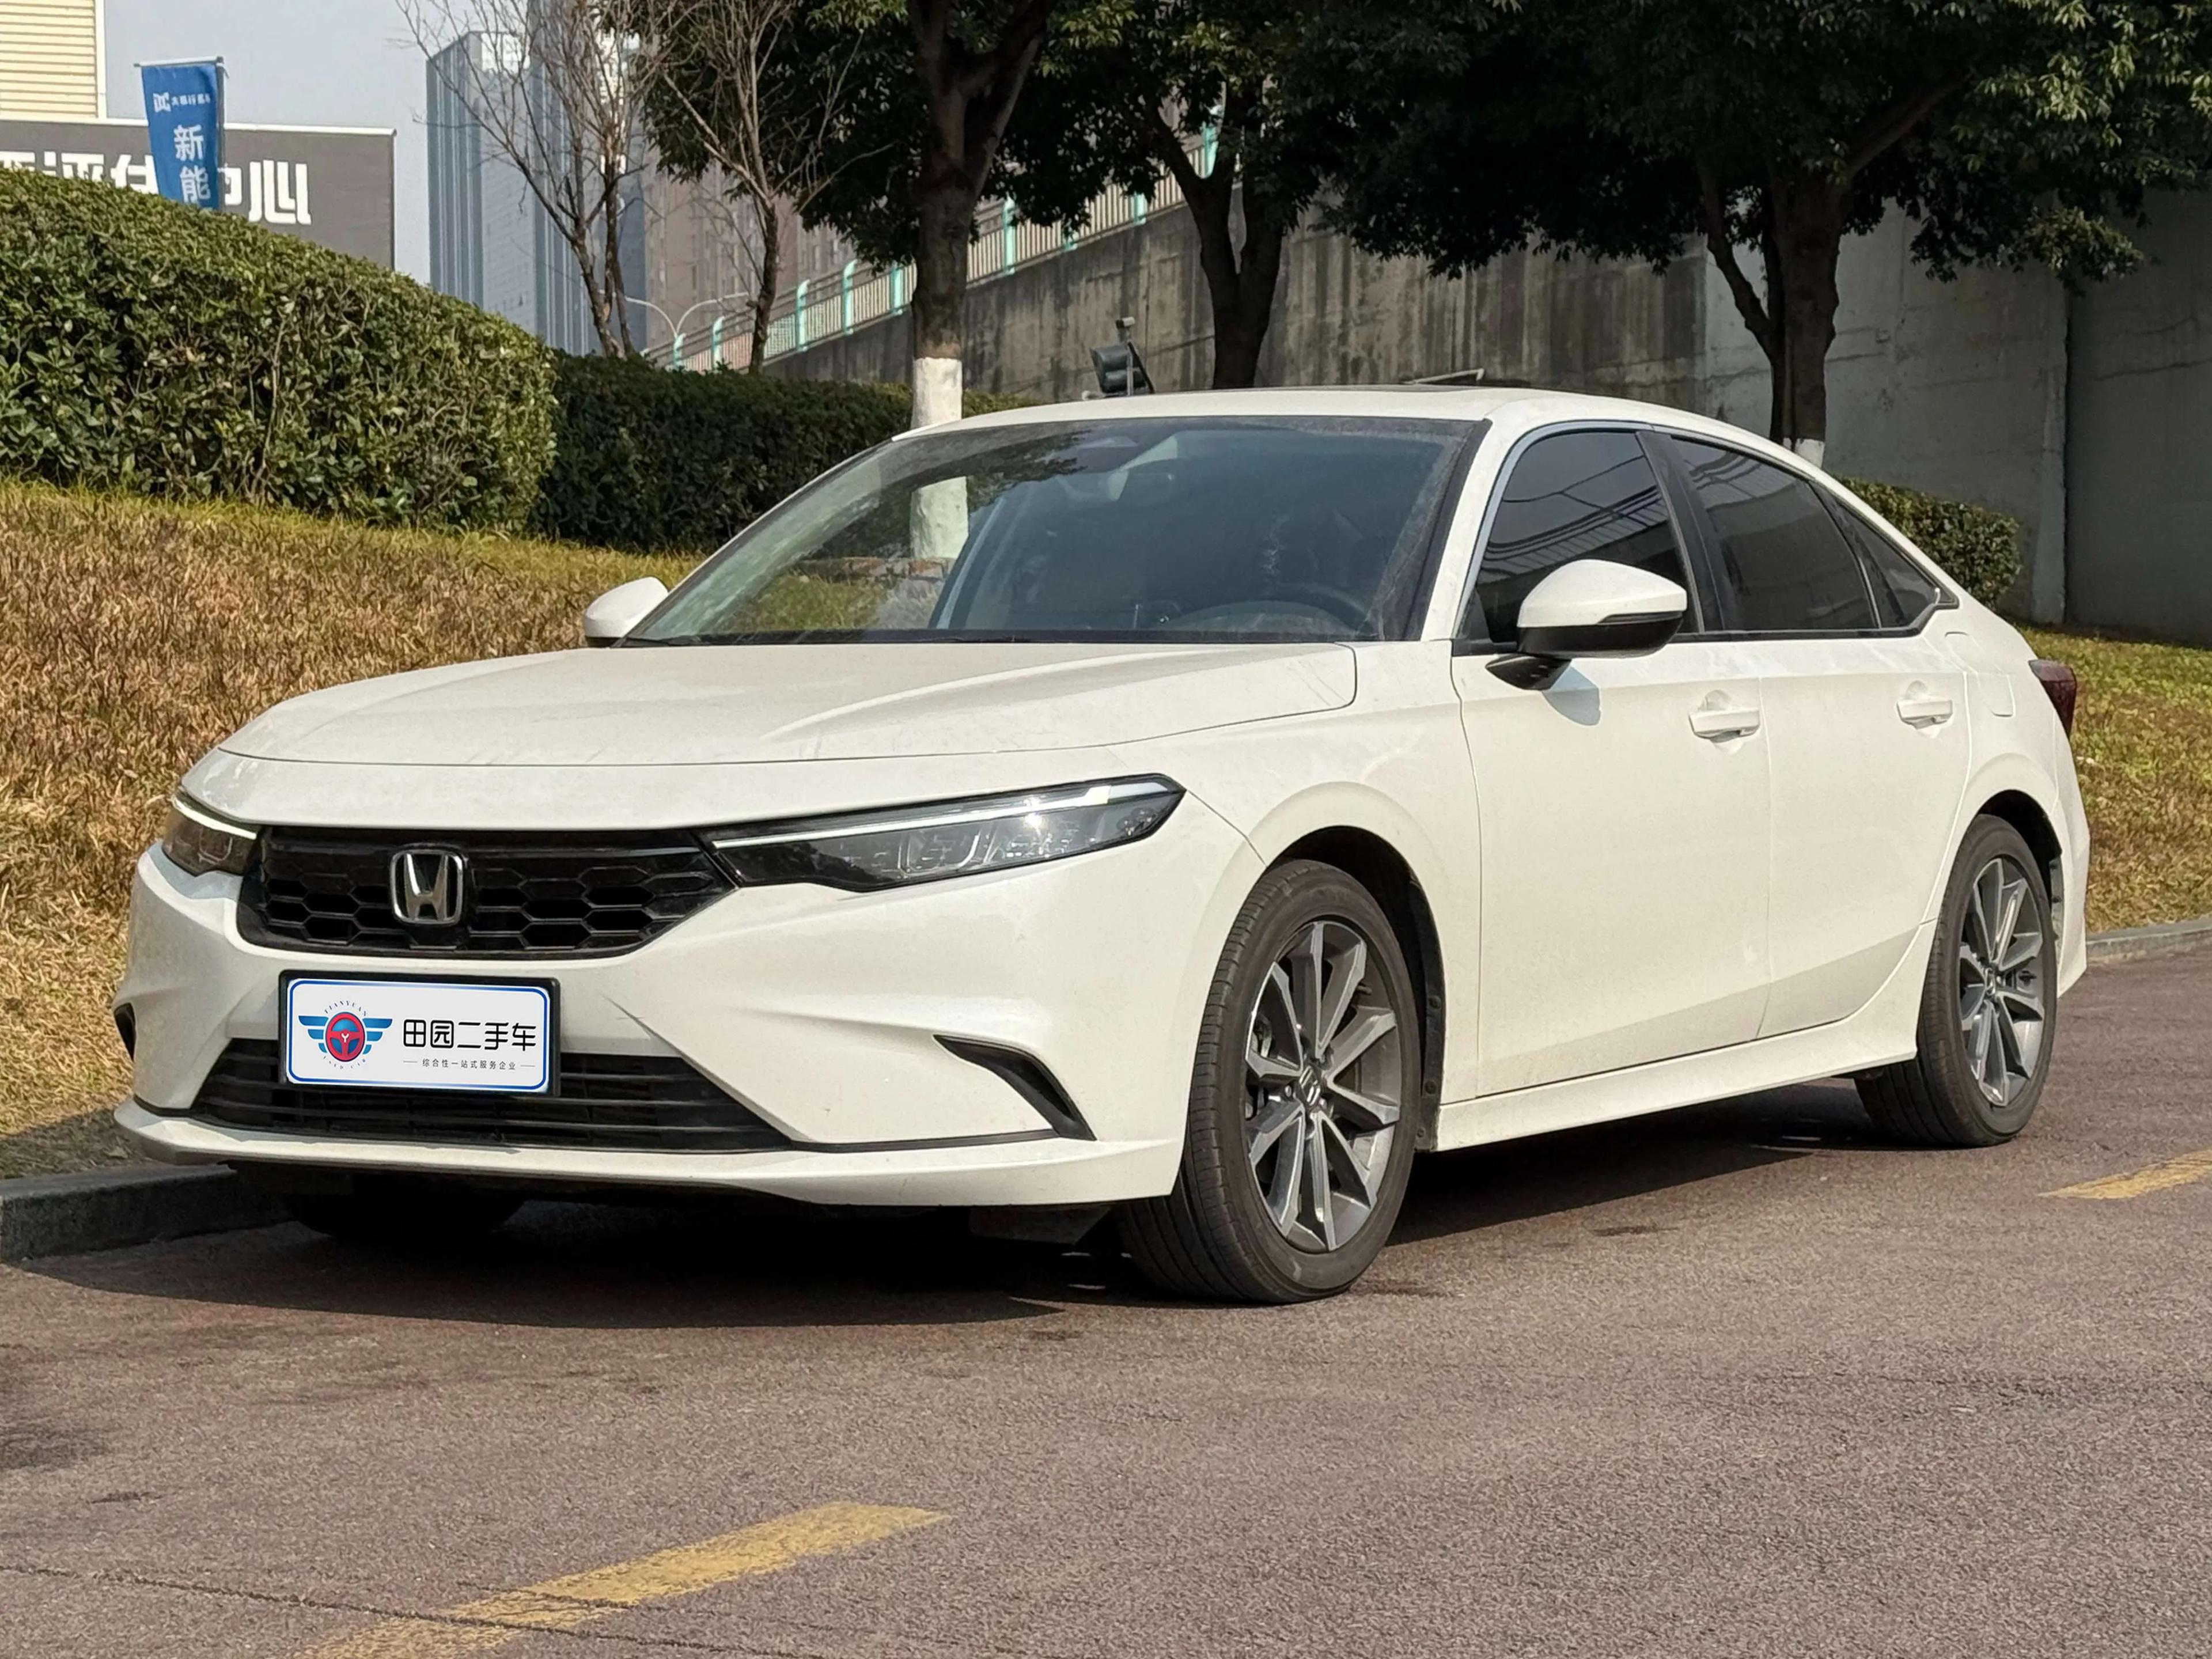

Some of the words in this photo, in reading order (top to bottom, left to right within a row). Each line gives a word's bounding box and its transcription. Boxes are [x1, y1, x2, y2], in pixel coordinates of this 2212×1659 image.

[403, 1019, 536, 1051] 田园二手车
[422, 1058, 516, 1070] 综合性一站式服务企业
